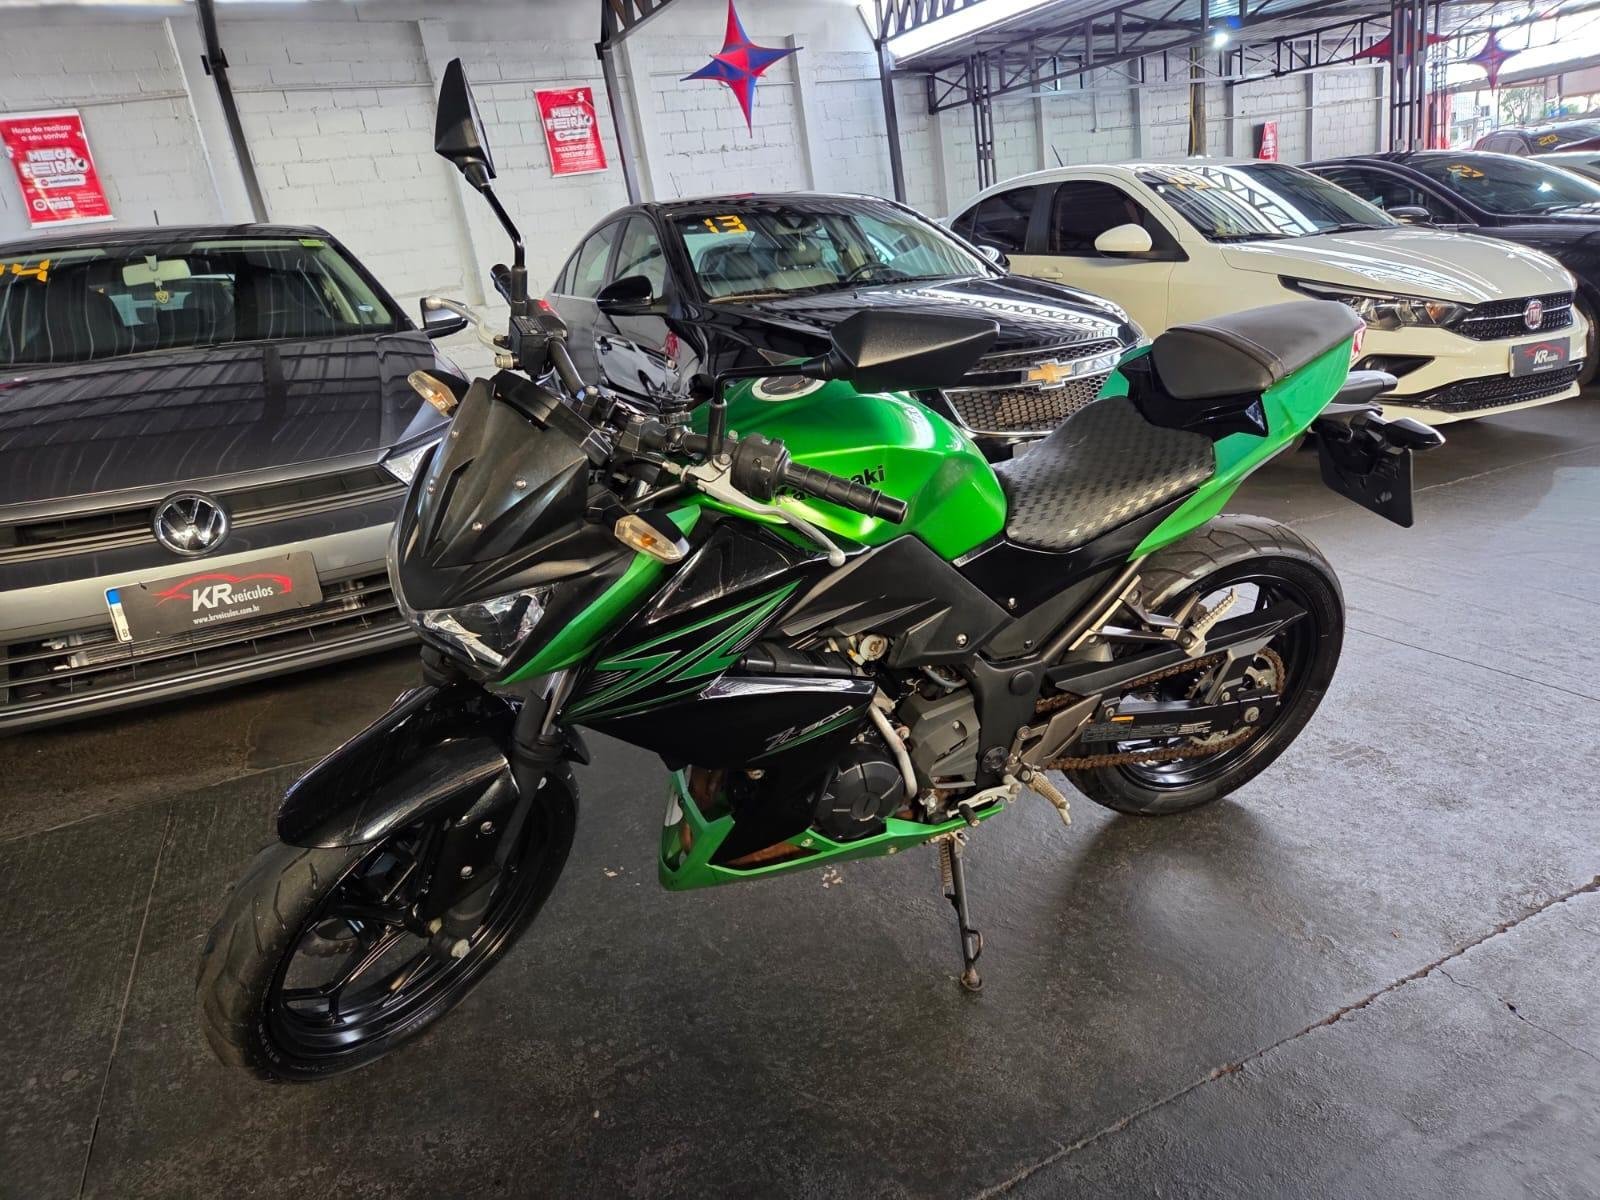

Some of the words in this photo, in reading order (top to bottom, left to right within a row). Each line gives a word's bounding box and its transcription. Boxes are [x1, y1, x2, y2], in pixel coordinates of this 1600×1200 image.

[550, 106, 583, 118] MEGA
[11, 126, 32, 134] Hora
[1537, 134, 1559, 146] 20
[26, 147, 76, 161] MEGA
[704, 215, 748, 234] 13
[1533, 349, 1549, 365] KR
[192, 583, 234, 612] KR
